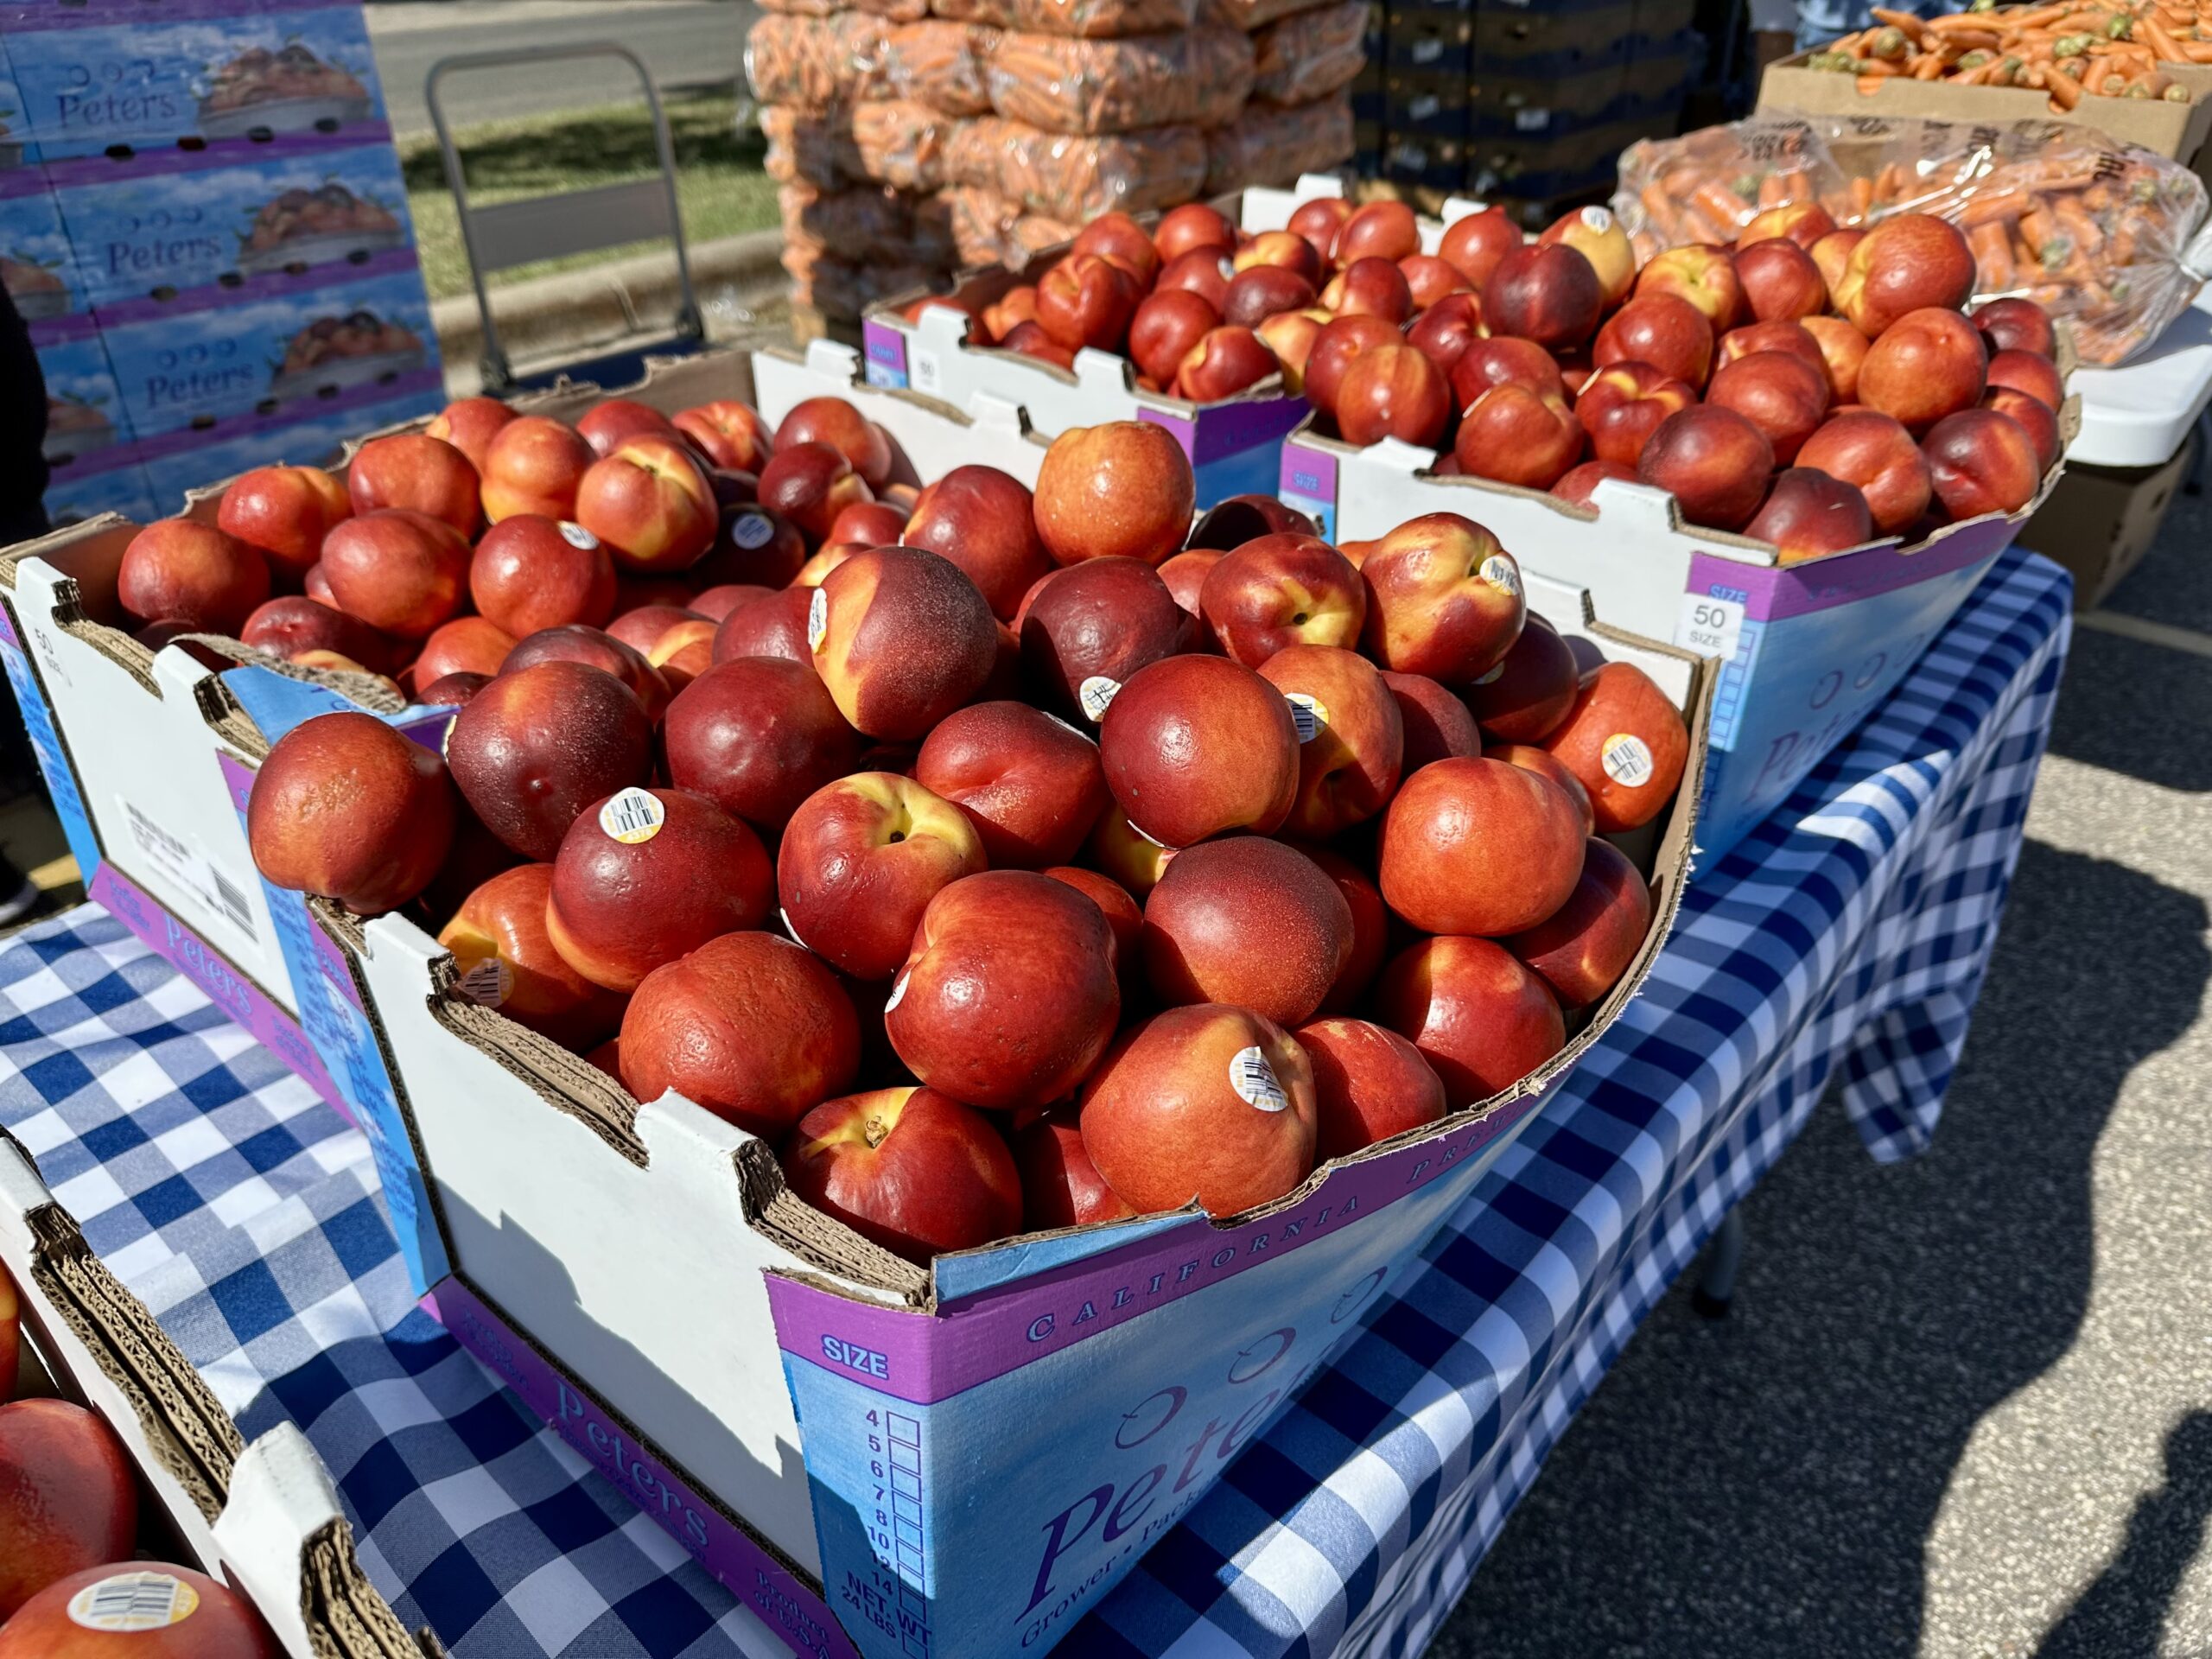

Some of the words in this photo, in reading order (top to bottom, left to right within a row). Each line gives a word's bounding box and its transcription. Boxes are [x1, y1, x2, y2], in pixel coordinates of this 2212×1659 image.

[57, 88, 177, 129] Peters
[106, 235, 222, 277] Peters
[145, 362, 255, 409] Peters
[1707, 582, 1749, 605] SIZE
[1693, 604, 1726, 629] 50
[34, 627, 54, 655] 50
[1688, 630, 1723, 649] SIZE
[162, 912, 256, 1016] Peters
[1025, 1193, 1360, 1344] CALIFORNIA
[821, 1333, 890, 1382] SIZE
[866, 1409, 880, 1428] 4
[868, 1433, 881, 1453] 5
[556, 1380, 710, 1549] Peters
[871, 1459, 883, 1478] 6
[873, 1484, 885, 1502] 7
[876, 1508, 888, 1527] 8
[868, 1525, 890, 1551] 10
[869, 1548, 892, 1573] 12
[872, 1570, 893, 1597] 14
[753, 1590, 773, 1614] of
[754, 1567, 830, 1643] Product
[841, 1585, 861, 1611] 24
[864, 1603, 896, 1639] LBS
[1020, 1555, 1119, 1649] Grower
[895, 1606, 933, 1646] WT
